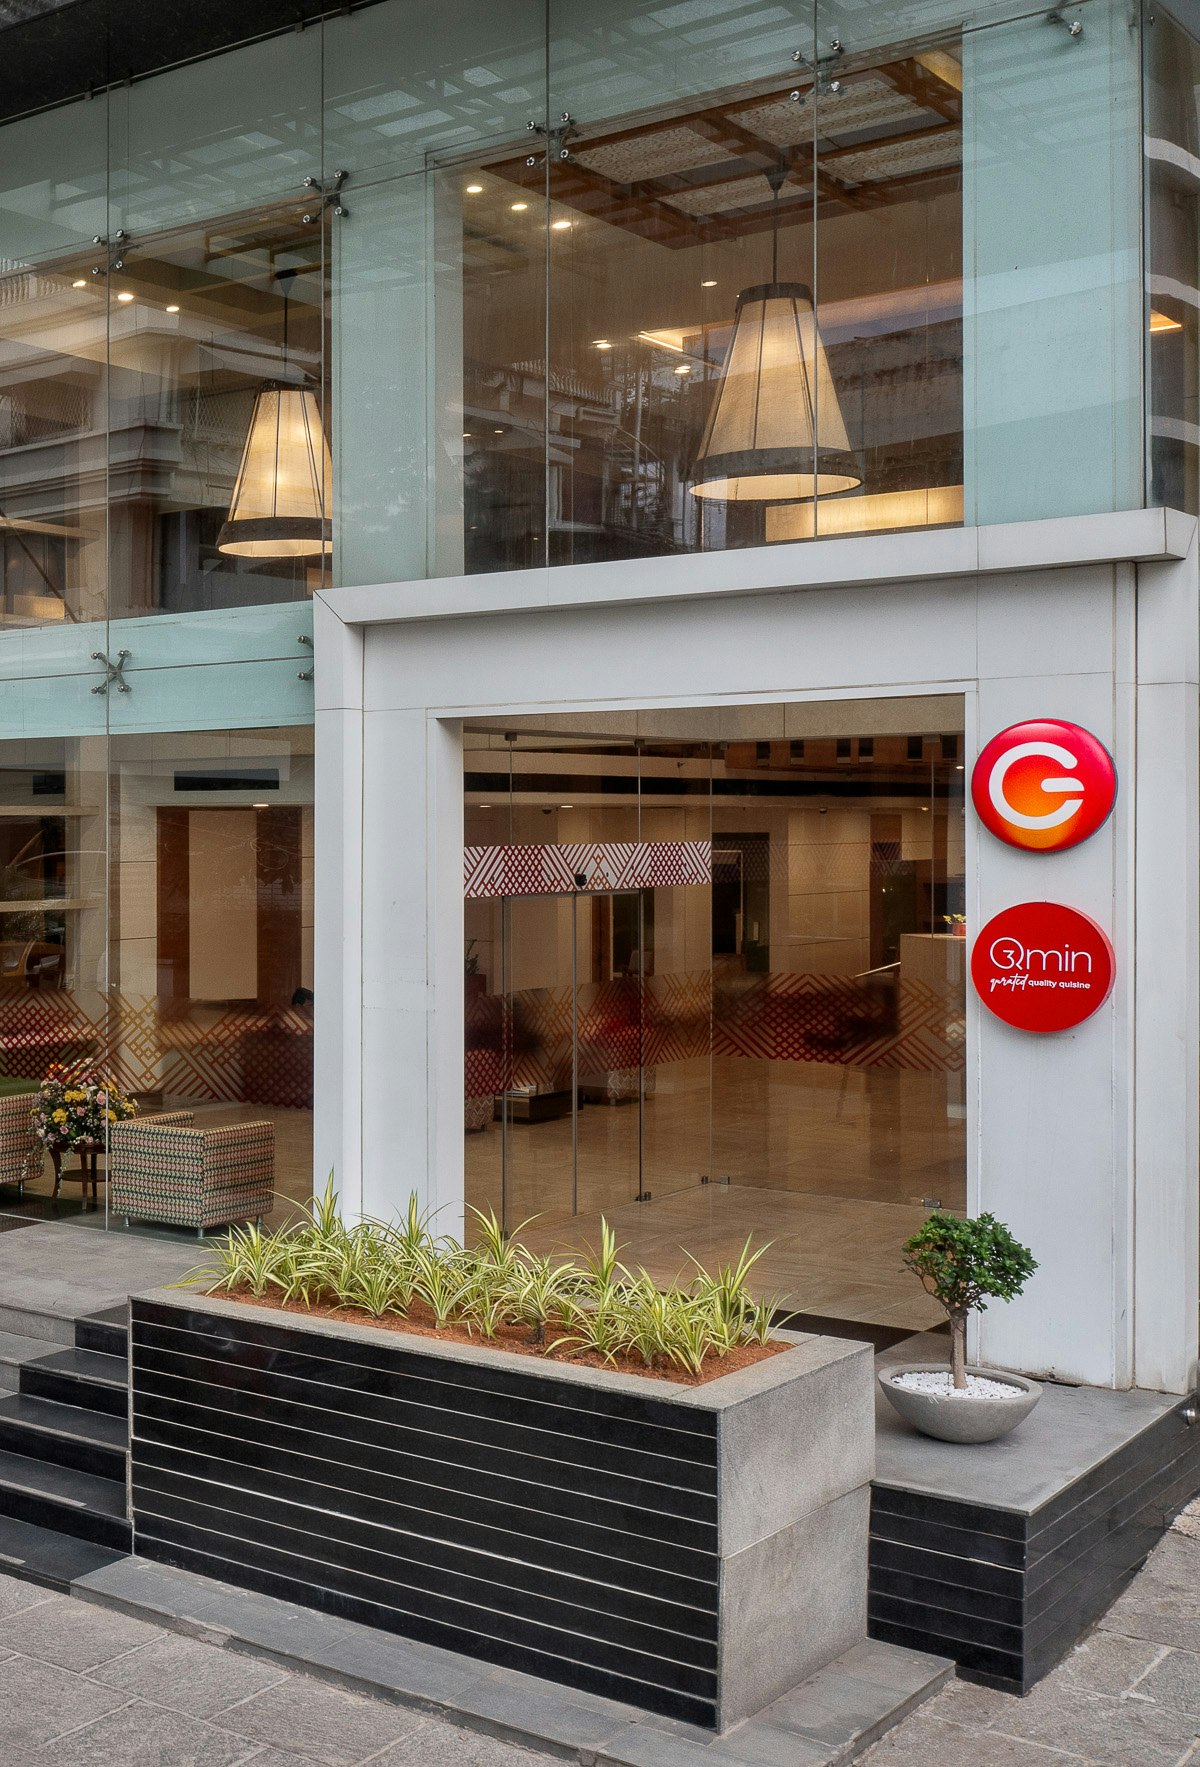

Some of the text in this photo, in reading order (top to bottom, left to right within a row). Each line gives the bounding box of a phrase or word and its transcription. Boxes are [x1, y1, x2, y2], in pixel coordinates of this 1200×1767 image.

[989, 937, 1092, 973] Qmin
[1028, 979, 1057, 988] quality
[1058, 980, 1091, 989] quisine
